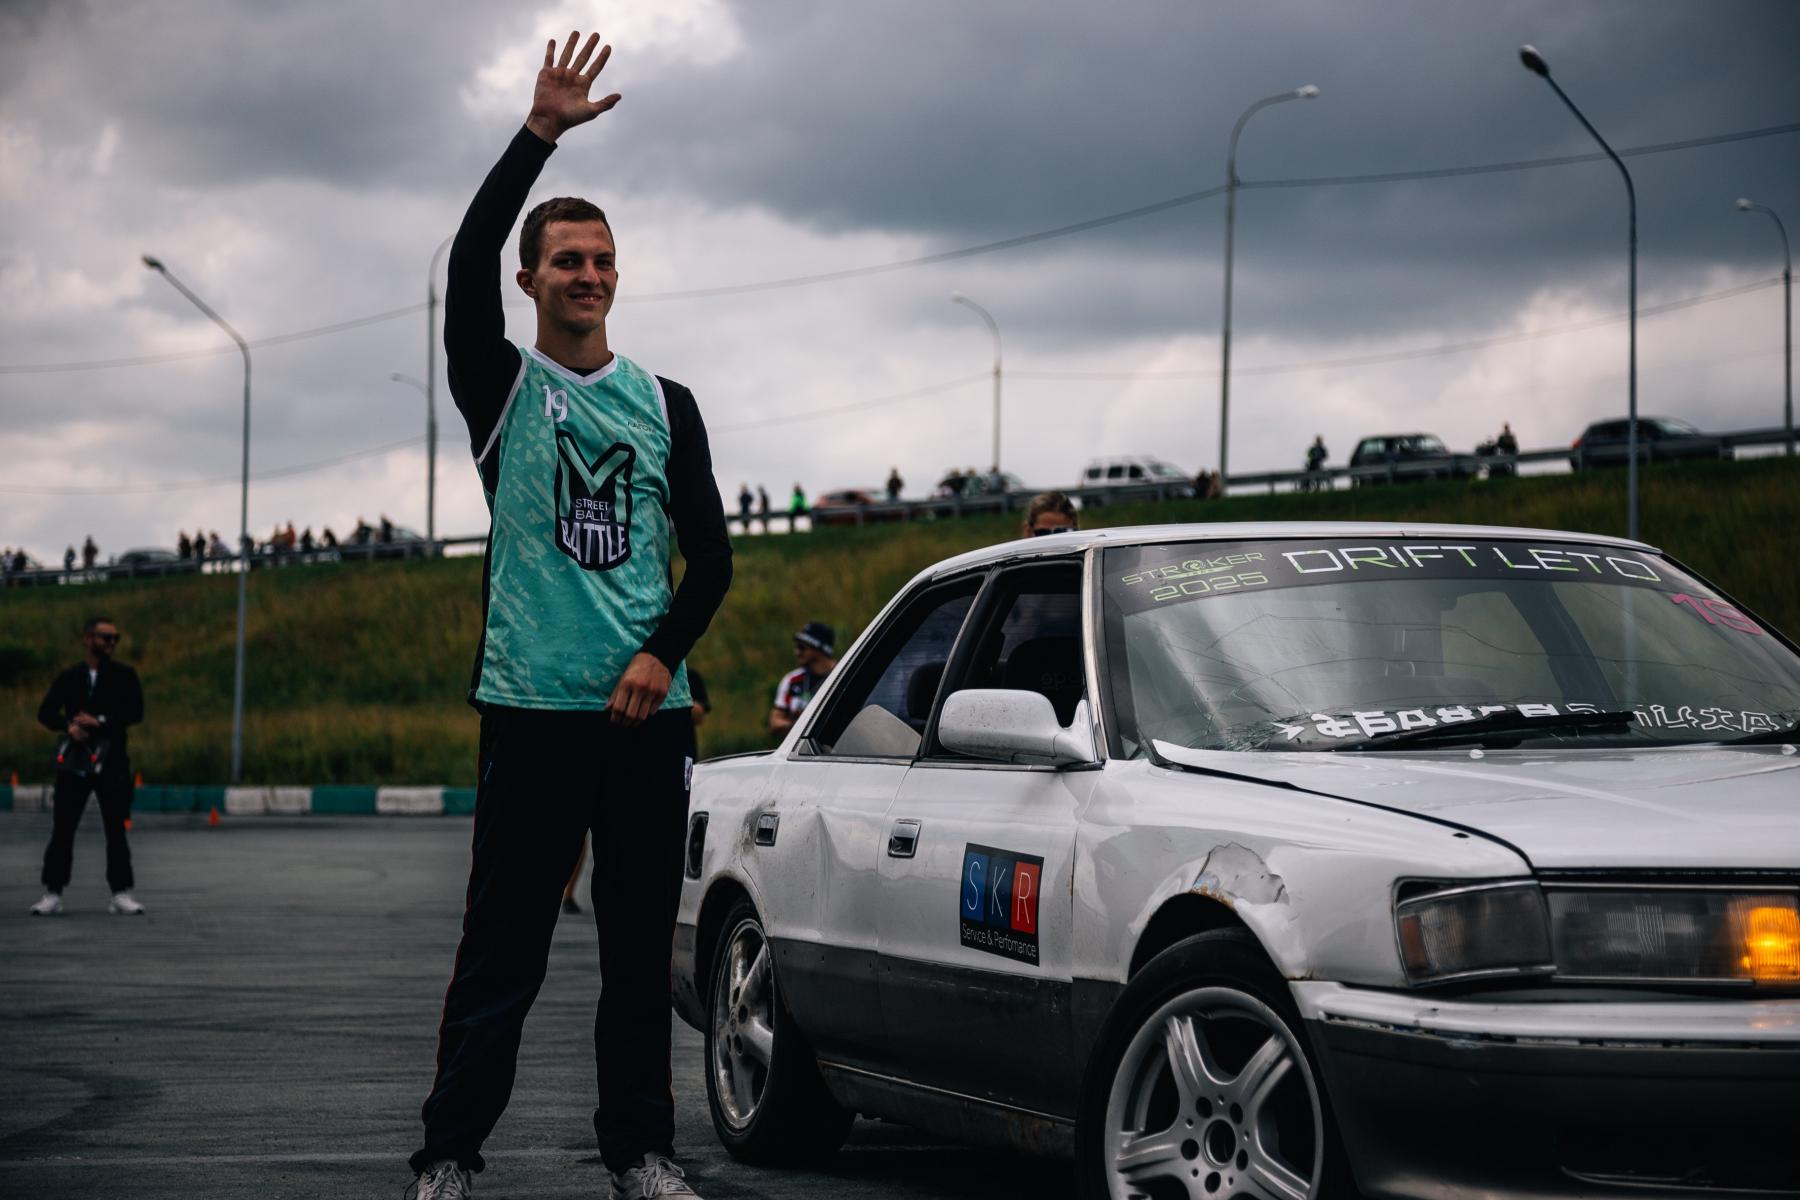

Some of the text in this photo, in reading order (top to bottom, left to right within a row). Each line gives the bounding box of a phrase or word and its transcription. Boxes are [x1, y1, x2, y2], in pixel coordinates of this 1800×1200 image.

[542, 384, 568, 423] 19
[575, 498, 609, 512] STREET
[575, 509, 610, 522] BALL
[560, 522, 627, 565] BATTLE
[1281, 545, 1662, 582] DRIFT LETO
[1149, 571, 1269, 601] 2025
[966, 861, 1031, 924] SKR
[962, 922, 986, 944] Service
